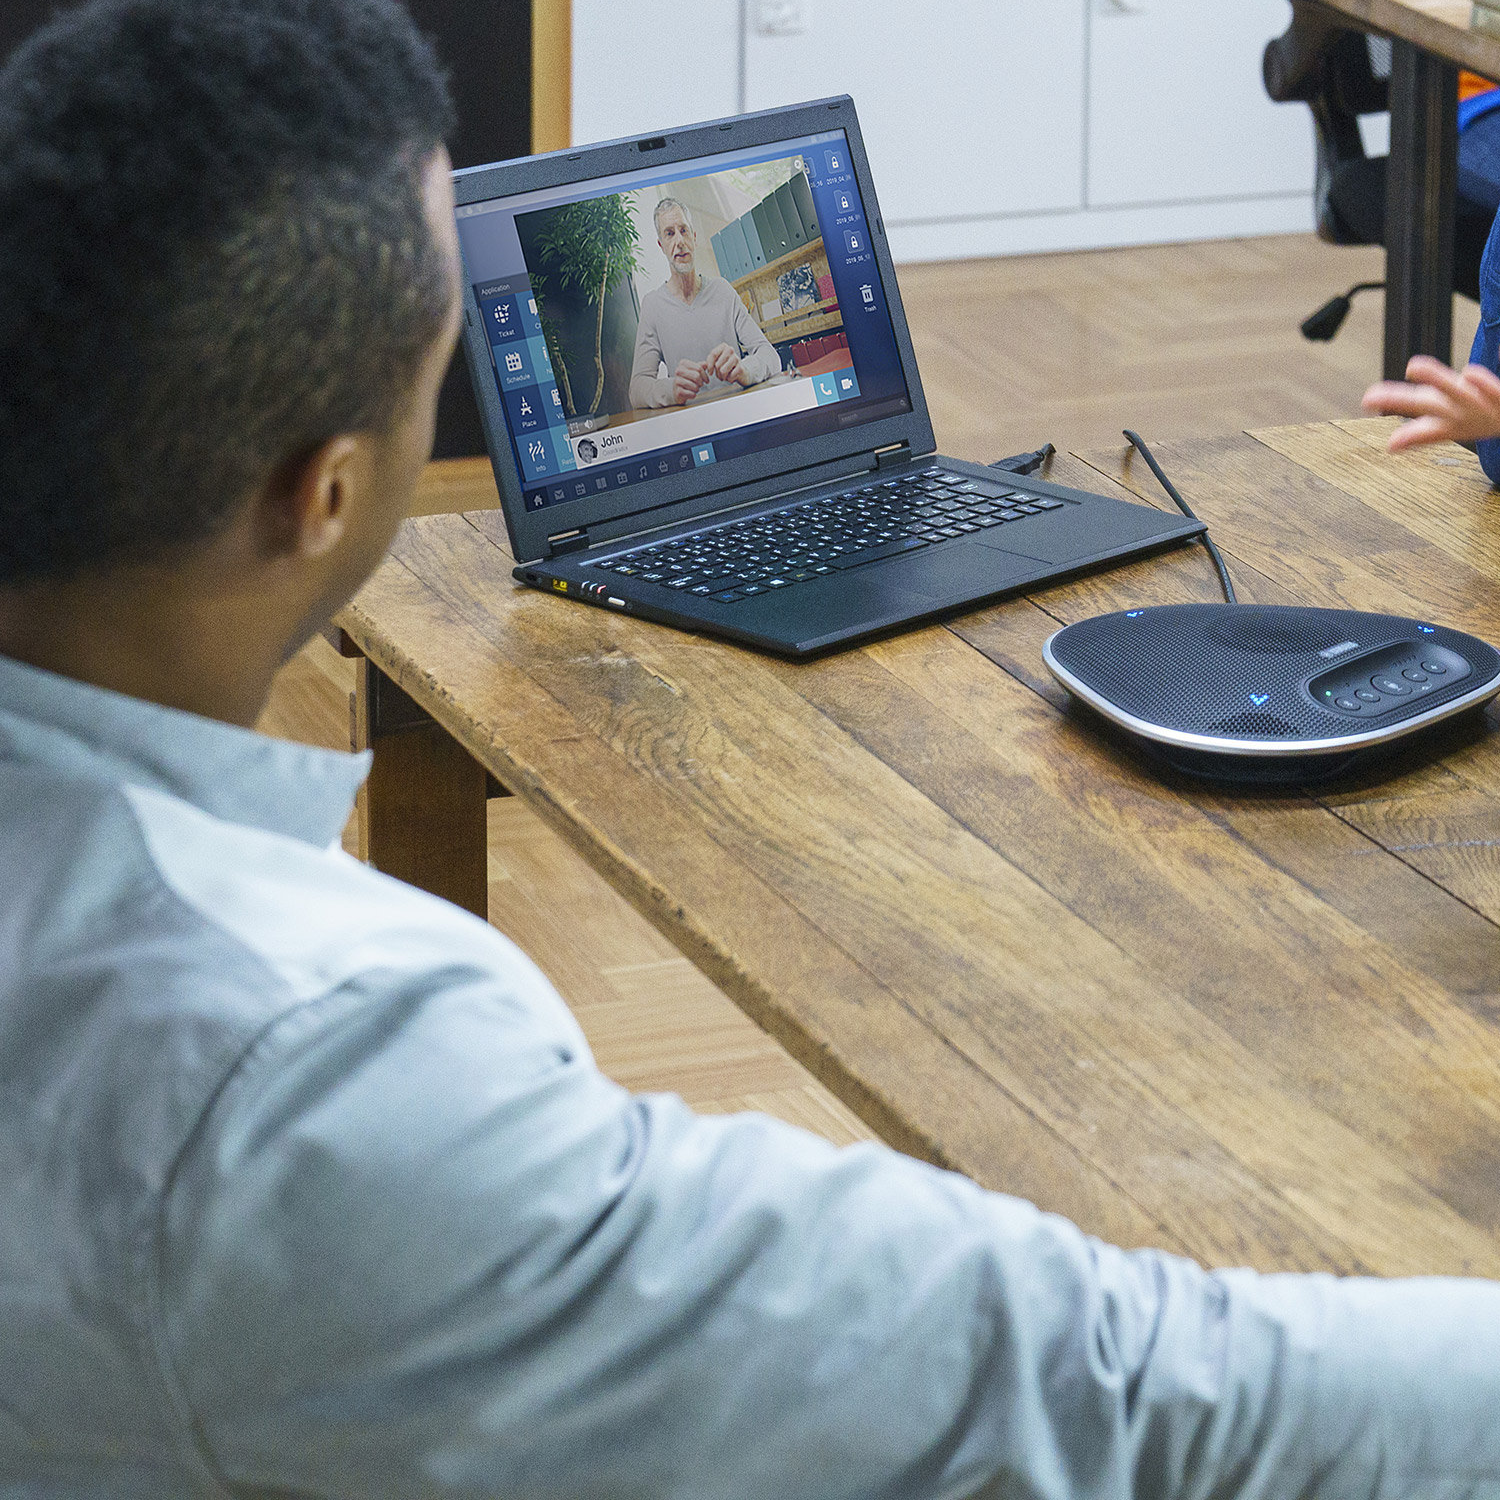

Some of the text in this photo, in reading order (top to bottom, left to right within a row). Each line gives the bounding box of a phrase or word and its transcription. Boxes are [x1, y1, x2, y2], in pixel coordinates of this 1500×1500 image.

[481, 284, 511, 296] Application
[864, 305, 877, 313] Trash
[498, 329, 516, 338] Ticket
[506, 373, 531, 384] Schedule
[521, 419, 537, 428] Place
[601, 434, 624, 448] John
[536, 464, 546, 472] Info
